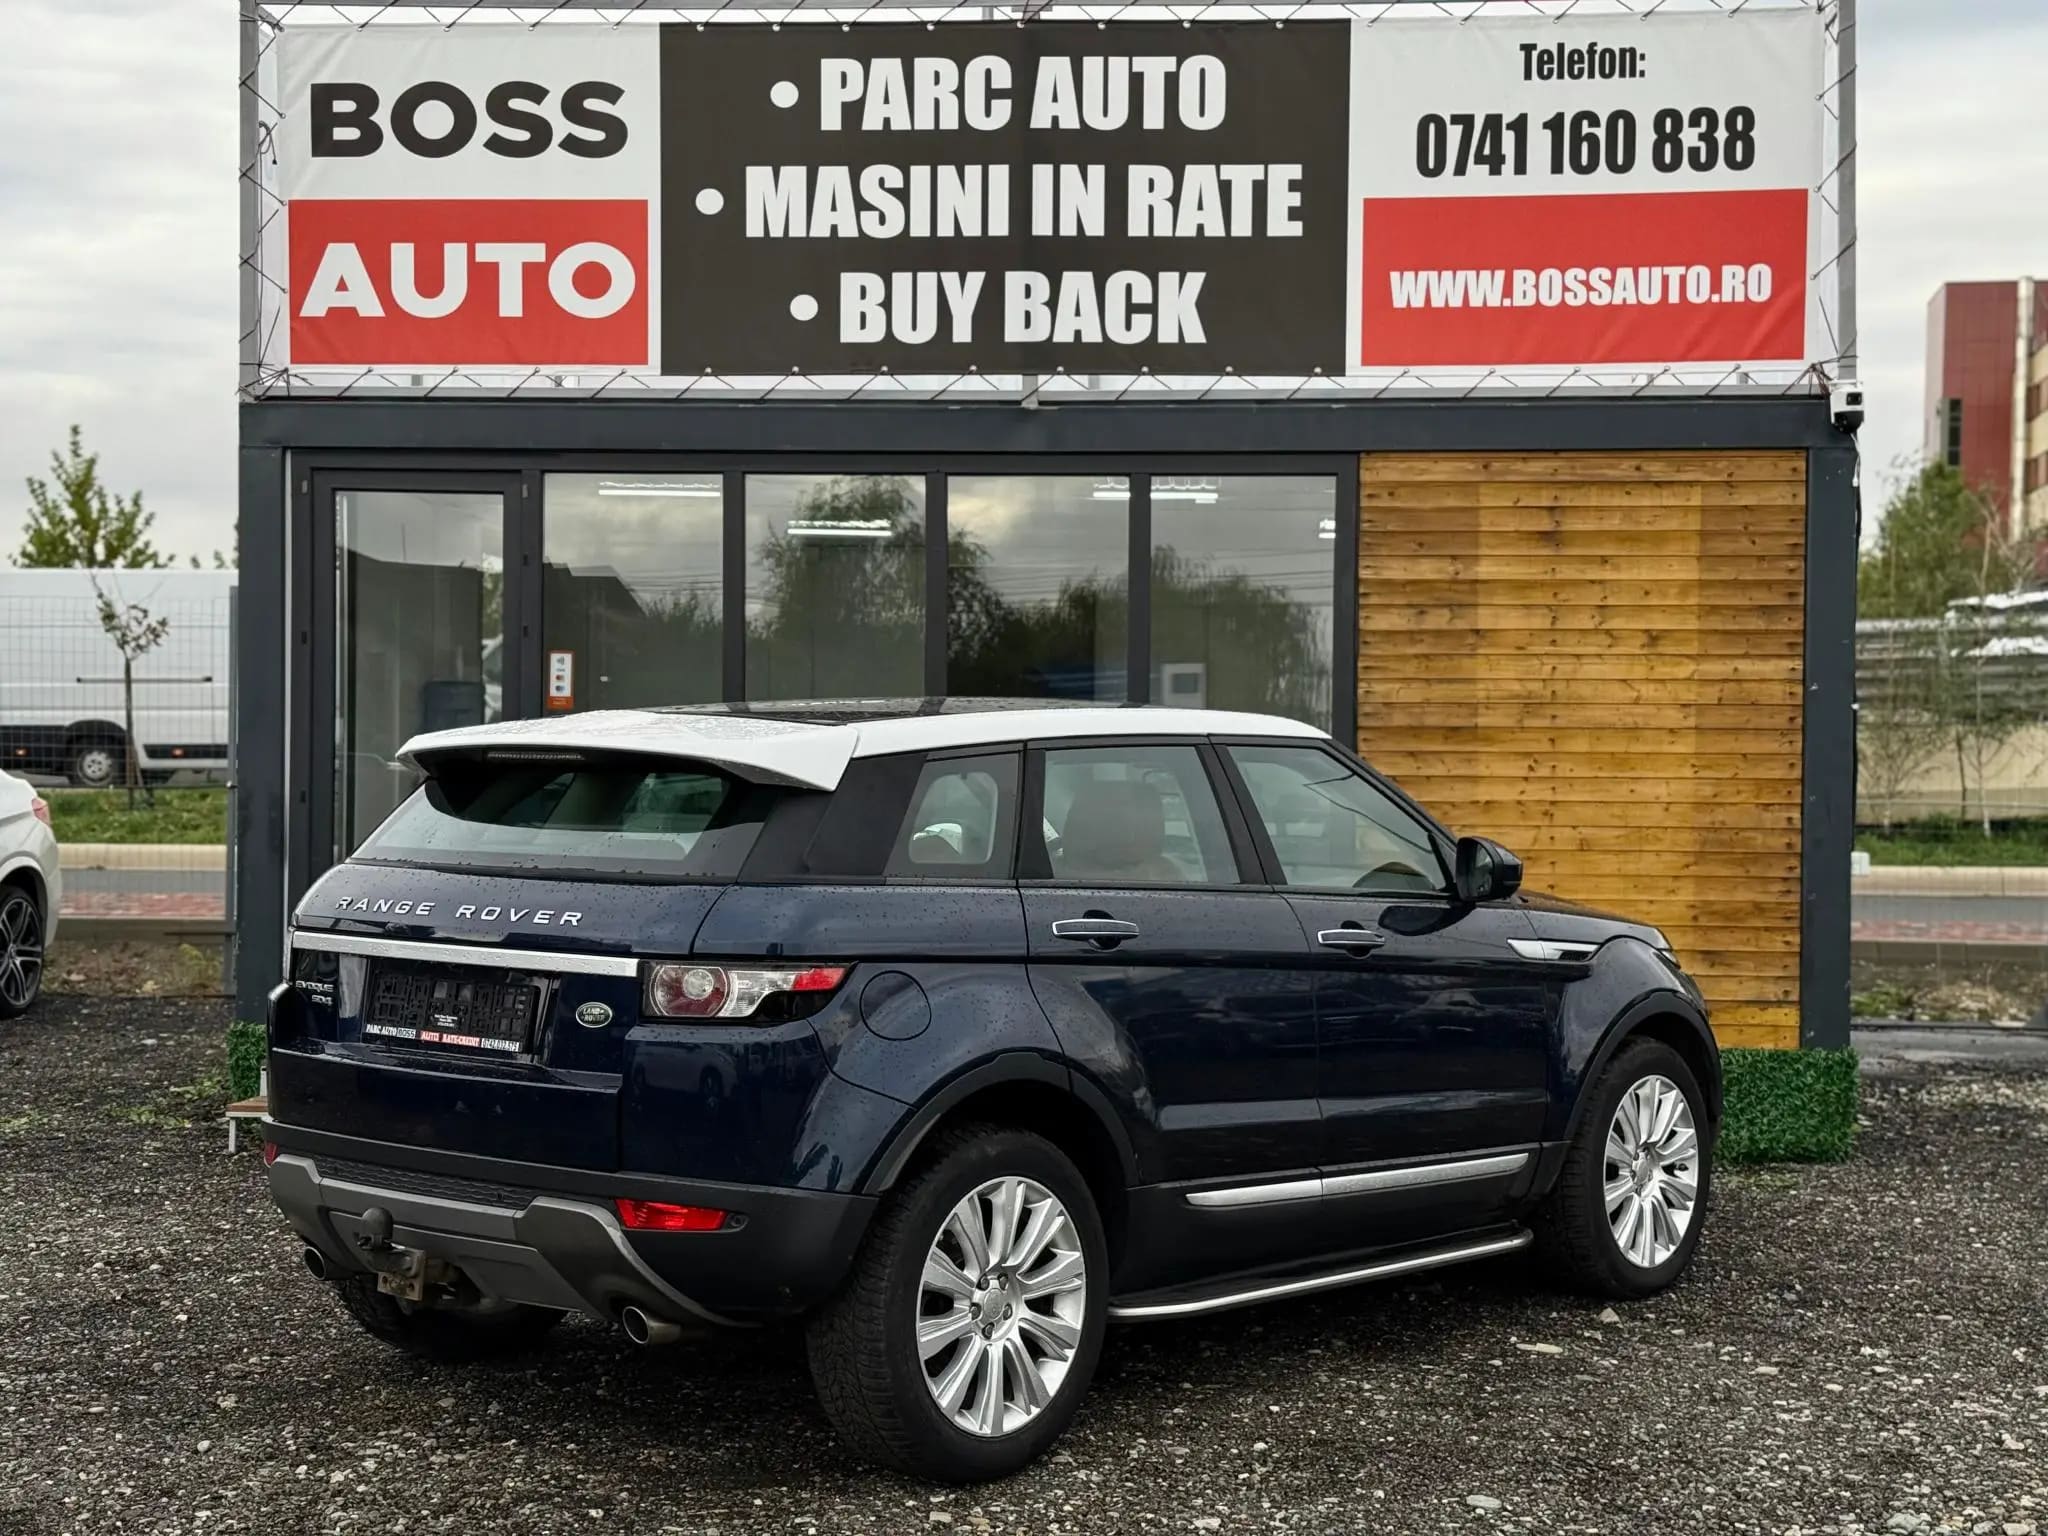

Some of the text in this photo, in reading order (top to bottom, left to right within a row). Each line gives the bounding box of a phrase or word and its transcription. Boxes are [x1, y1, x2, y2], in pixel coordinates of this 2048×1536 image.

[1520, 42, 1646, 80] Telefon:
[311, 81, 628, 159] BOSS
[820, 55, 1227, 131] PARC AUTO
[1416, 106, 1756, 178] 0741 160 838
[745, 163, 1303, 239] MASINI IN RATE
[299, 241, 636, 319] AUTO
[839, 270, 1207, 345] BUY BACK
[1389, 263, 1772, 309] WWW.BOSSAUTO.RO
[335, 896, 583, 926] RANGE ROVER
[295, 980, 334, 992] EVOQUE
[583, 1007, 600, 1015] LAND
[365, 1023, 381, 1034] PARC
[381, 1025, 397, 1036] AUTO
